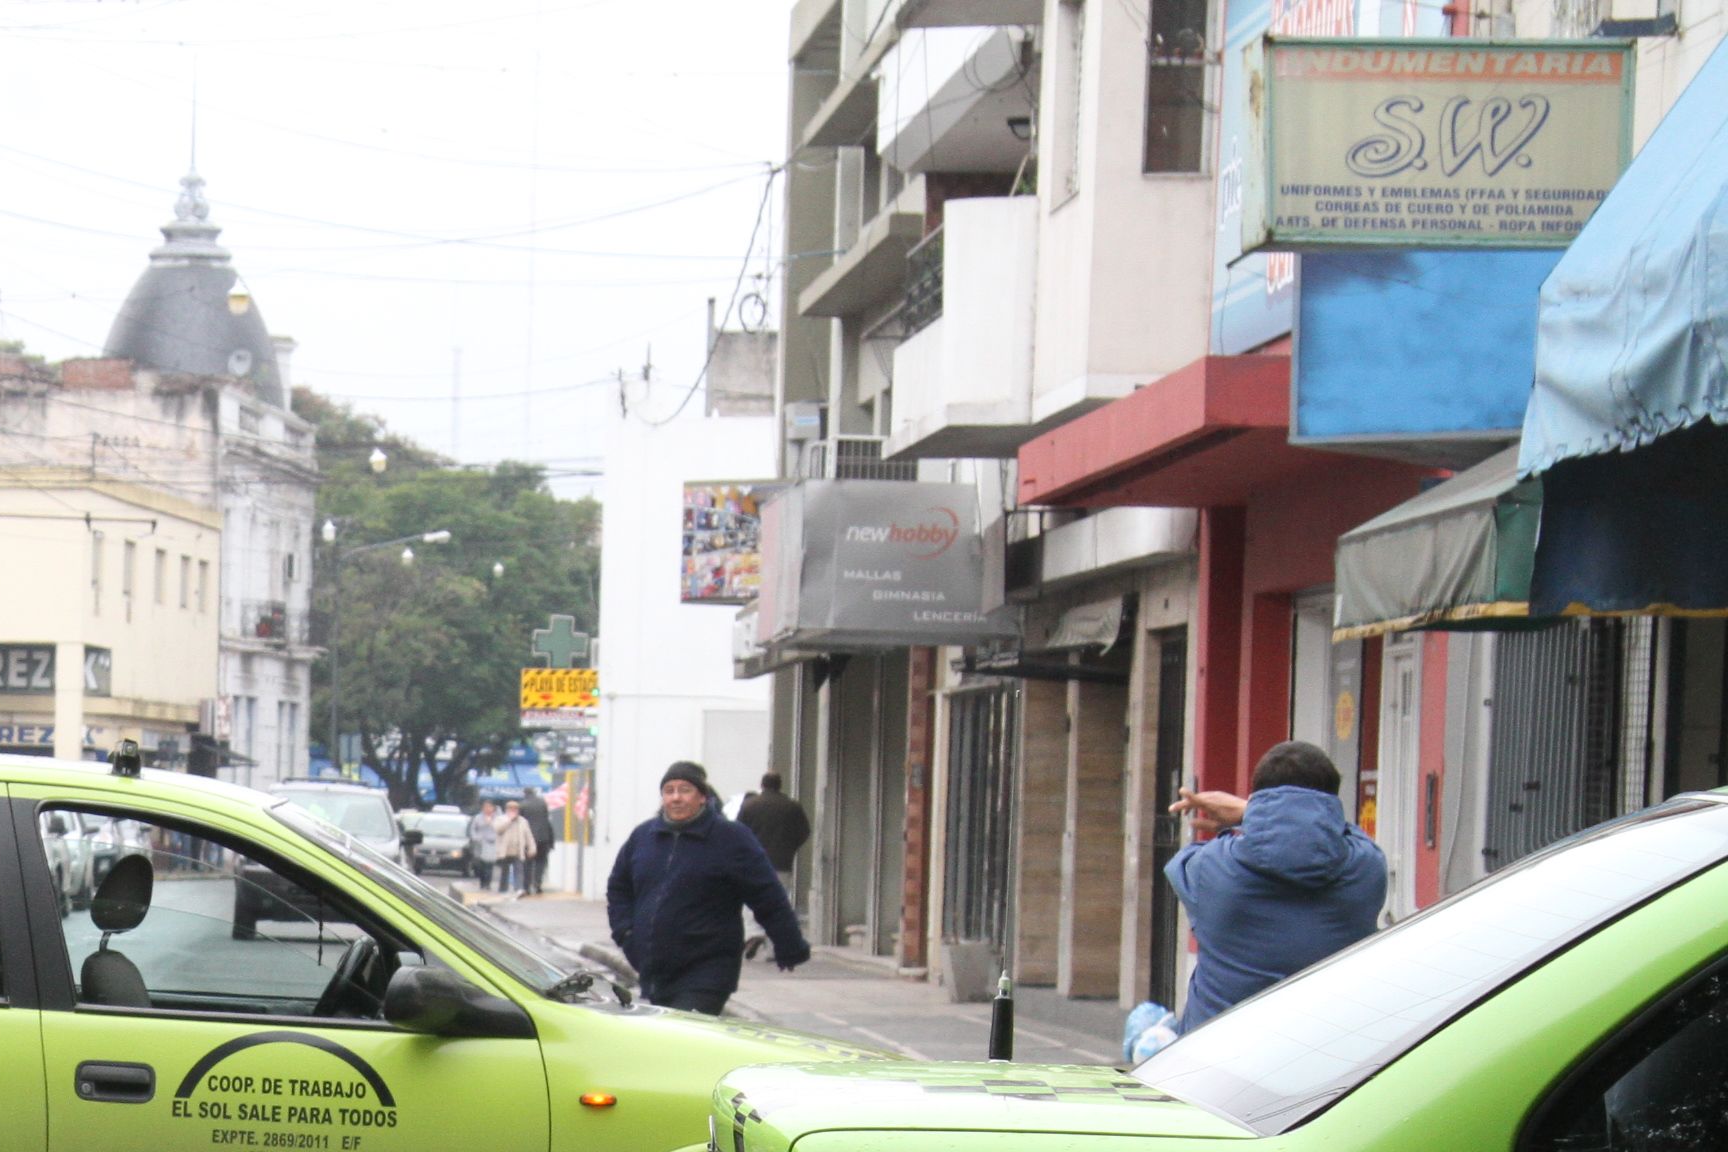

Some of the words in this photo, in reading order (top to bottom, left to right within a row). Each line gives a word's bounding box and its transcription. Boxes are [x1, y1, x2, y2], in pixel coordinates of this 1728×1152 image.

[1278, 49, 1613, 76] INDUMENTARIA
[1280, 184, 1362, 197] UNIFORMES
[1368, 186, 1376, 198] Y
[1382, 186, 1460, 199] EMBLEMAS
[1465, 188, 1505, 201] (FFAA
[1512, 188, 1520, 200] Y
[1315, 201, 1379, 213] CORREAS
[1385, 202, 1401, 213] DE
[1408, 203, 1453, 214] CUERO
[1459, 204, 1468, 214] Y
[1473, 204, 1489, 215] DE
[1495, 204, 1574, 216] POLIAMIDA
[1322, 217, 1338, 227] DE
[1344, 217, 1406, 229] DEFENSA
[1412, 218, 1483, 231] PERSONAL
[1499, 219, 1536, 231] ROPA
[843, 569, 902, 581] MALLAS
[873, 589, 946, 601] GIMNASIA
[207, 1075, 256, 1093] COOP.
[262, 1077, 283, 1095] DE
[288, 1079, 367, 1099] TRABAJO
[172, 1100, 193, 1118] EL
[198, 1101, 232, 1120] SOL
[238, 1103, 282, 1122] SALE
[287, 1106, 332, 1125] PARA
[339, 1108, 398, 1128] TODOS
[212, 1128, 259, 1146] EXPTE.
[263, 1132, 329, 1149] 2869/2011
